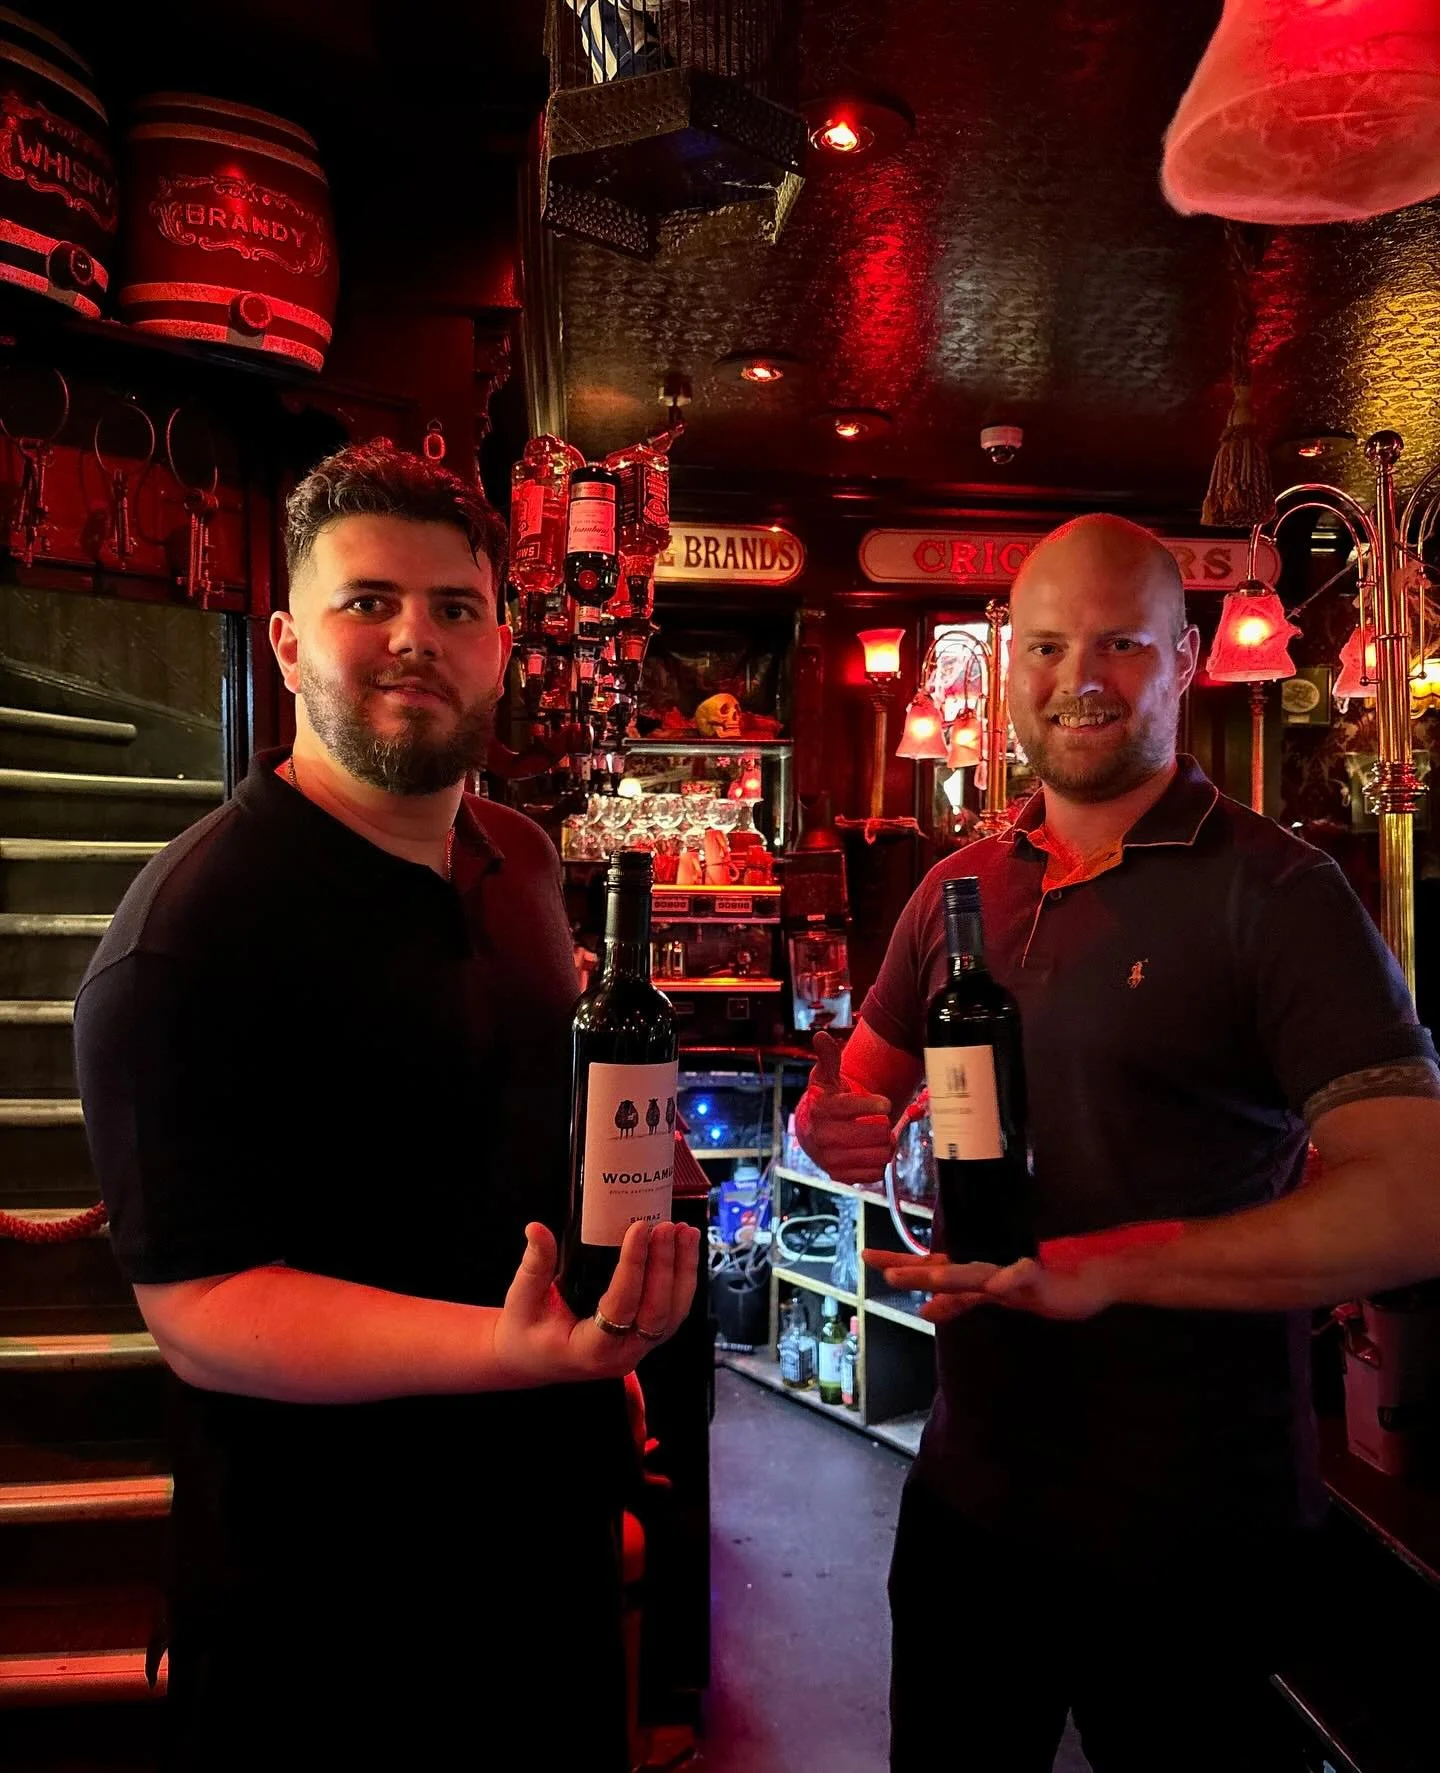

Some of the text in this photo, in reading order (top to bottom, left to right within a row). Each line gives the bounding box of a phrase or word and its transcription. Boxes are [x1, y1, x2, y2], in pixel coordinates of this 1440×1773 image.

[17, 134, 113, 206] WHISKY
[186, 203, 306, 248] BRANDY
[684, 535, 796, 571] BRANDS
